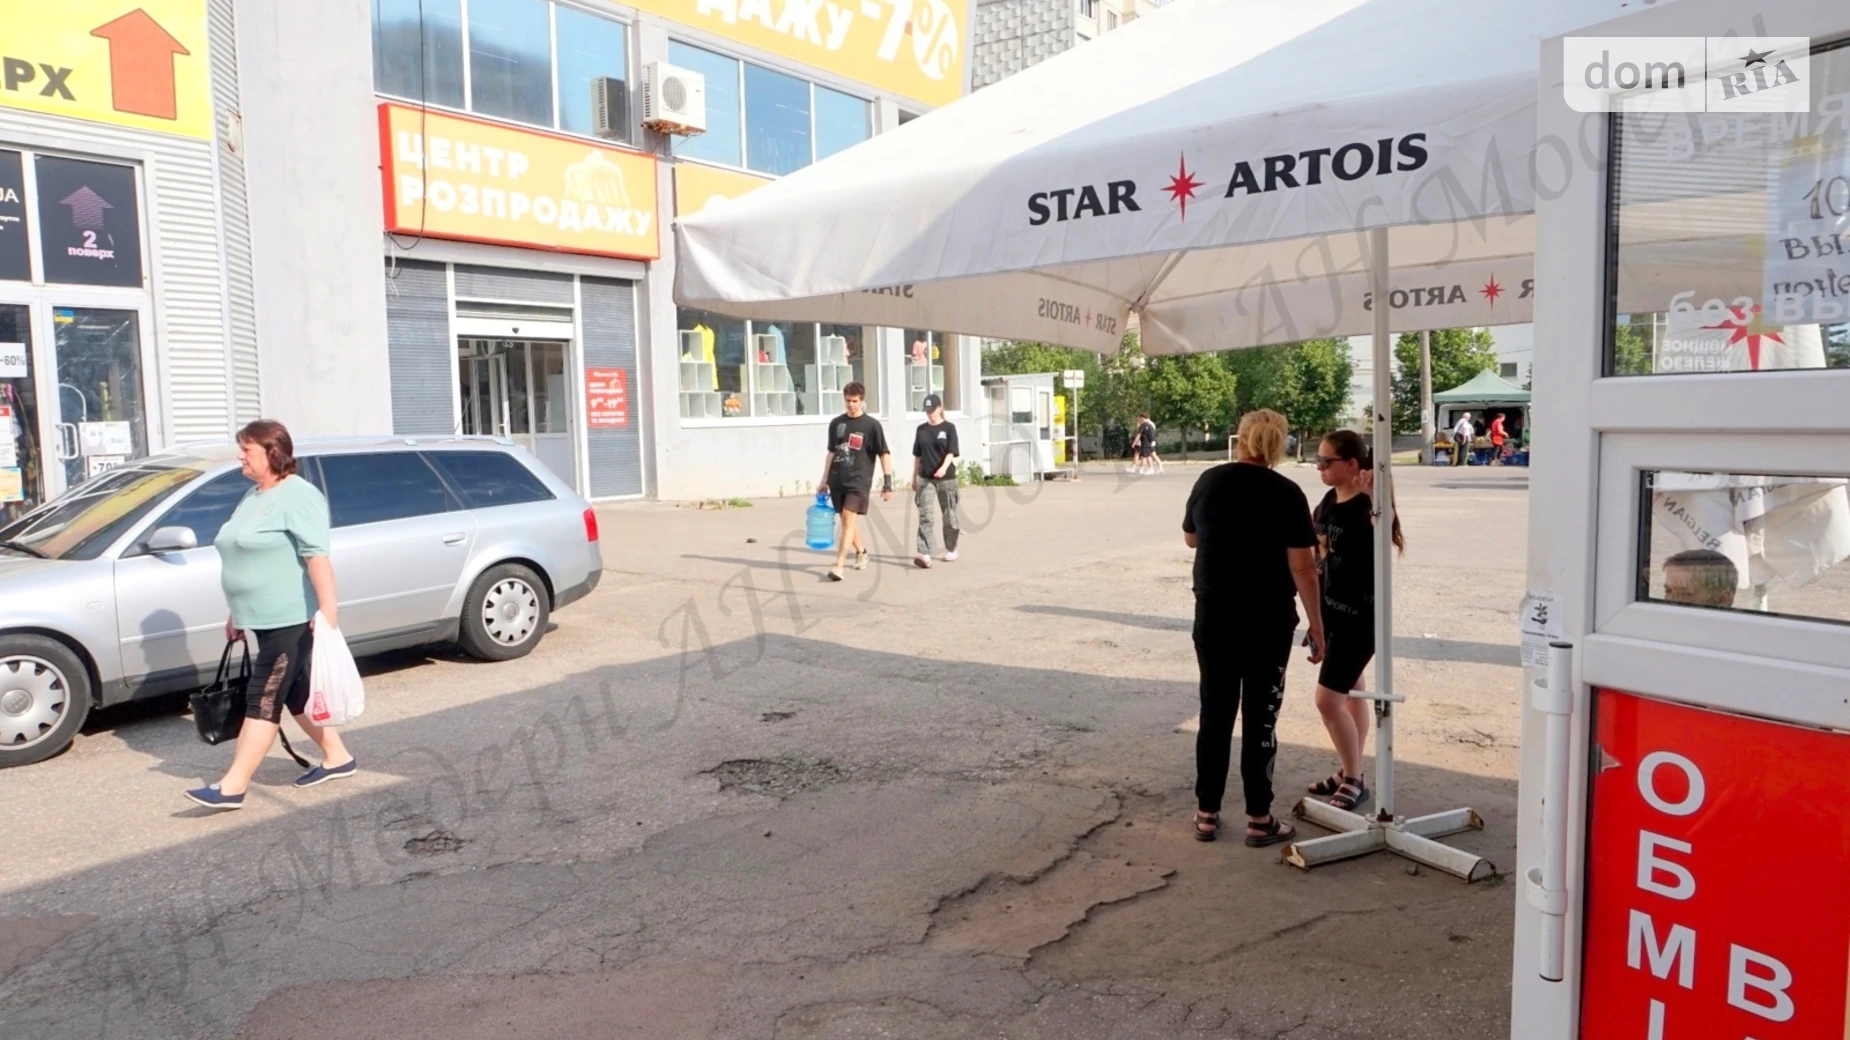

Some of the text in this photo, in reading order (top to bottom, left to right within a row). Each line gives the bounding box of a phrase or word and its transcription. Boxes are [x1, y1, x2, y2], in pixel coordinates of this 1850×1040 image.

[0, 56, 77, 102] РХ
[397, 130, 529, 180] ЦЕНТР
[1027, 133, 1428, 226] STAR ARTOIS
[401, 175, 652, 236] РОЗПРОДАЖУ
[68, 246, 115, 260] поверх
[83, 230, 97, 249] 2
[1669, 290, 1755, 329] без
